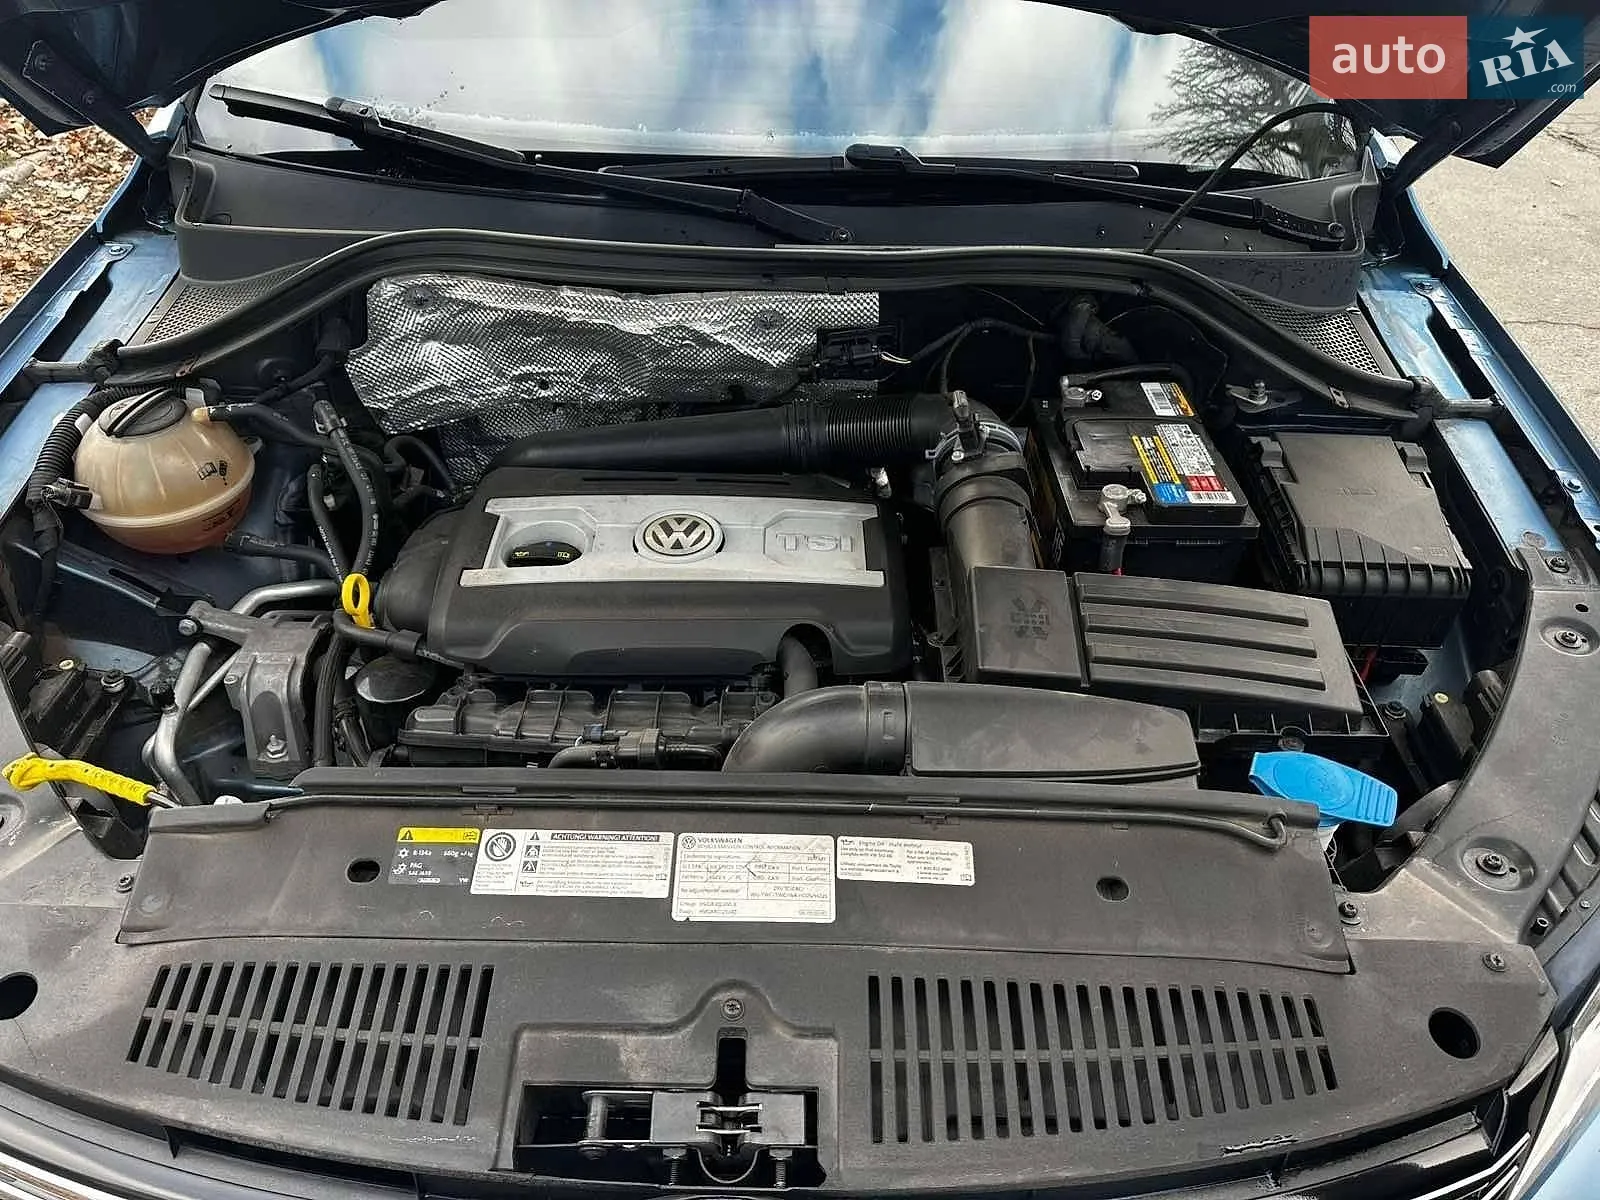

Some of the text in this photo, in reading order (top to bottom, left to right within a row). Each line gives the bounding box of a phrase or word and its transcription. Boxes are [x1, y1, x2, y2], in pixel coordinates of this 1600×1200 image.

[775, 531, 854, 553] TSI
[552, 832, 659, 842] ACHTUNG! WARNING! ATTENTION!
